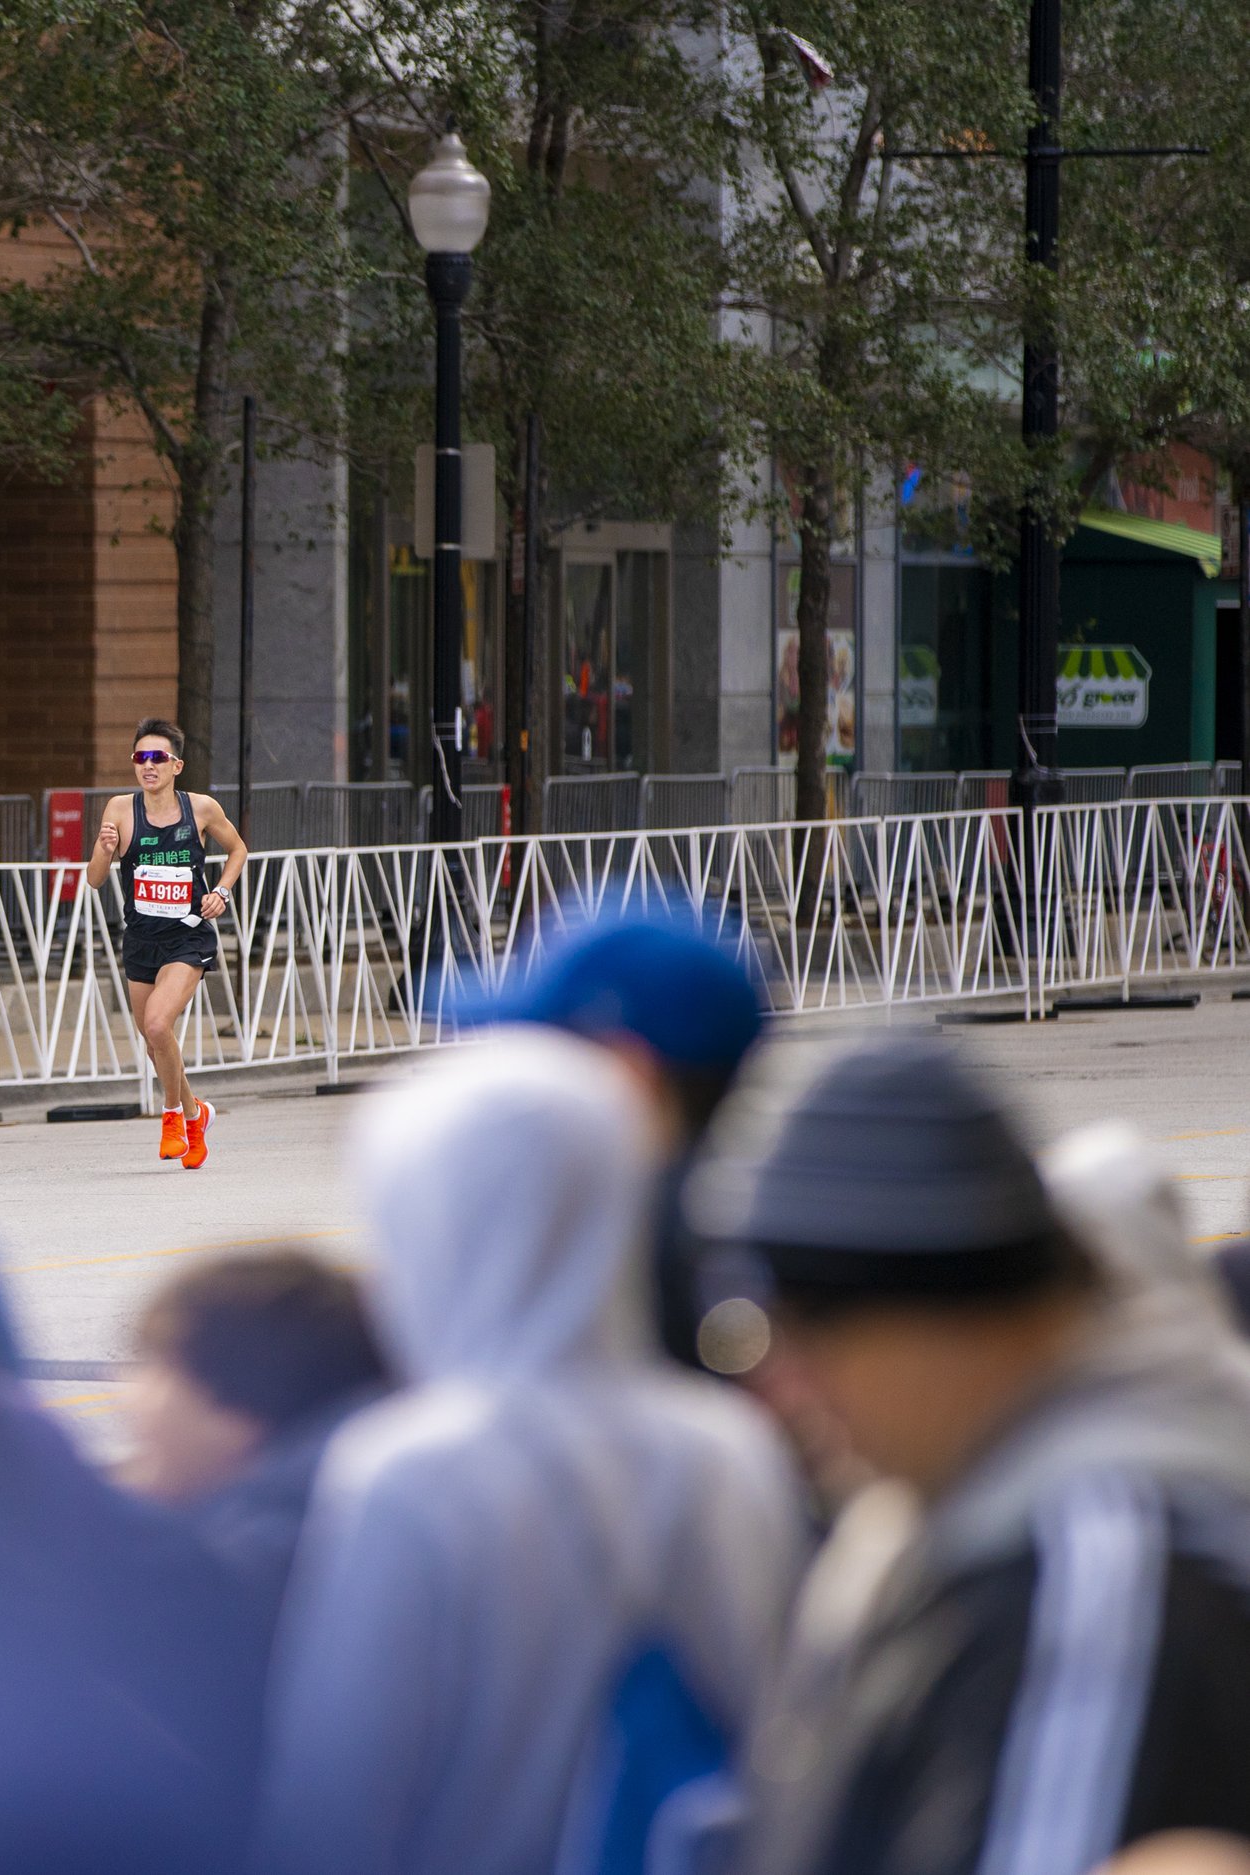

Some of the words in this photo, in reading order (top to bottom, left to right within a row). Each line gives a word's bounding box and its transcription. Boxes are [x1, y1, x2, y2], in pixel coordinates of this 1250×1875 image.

[139, 850, 191, 865] 华润怡宝
[138, 883, 147, 898] A
[150, 884, 188, 900] 19184
